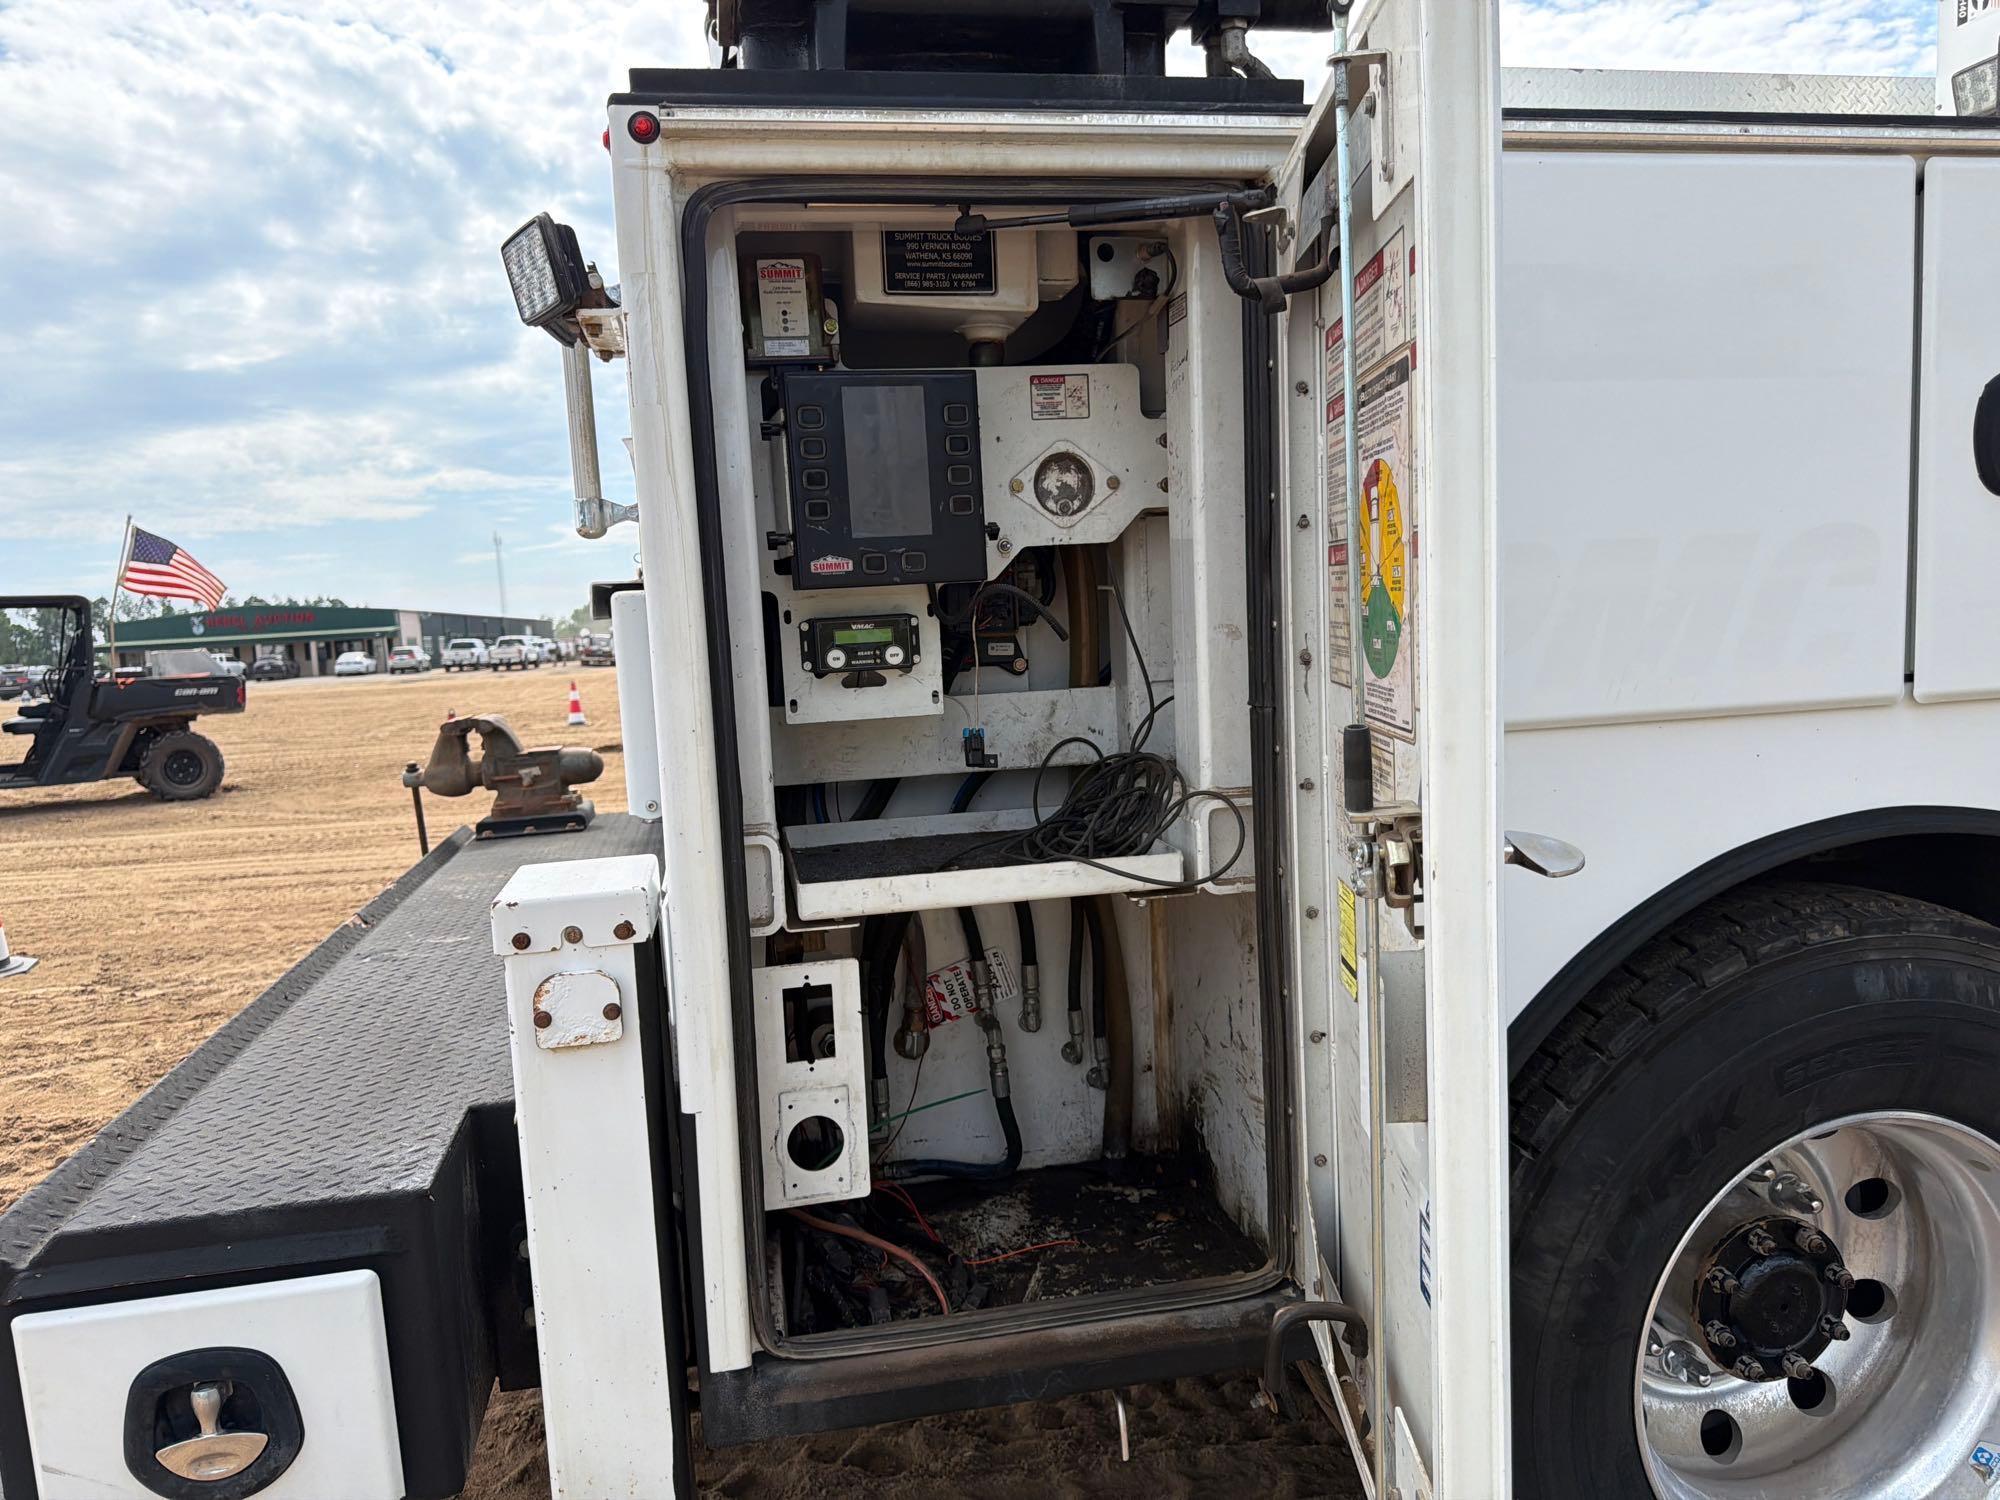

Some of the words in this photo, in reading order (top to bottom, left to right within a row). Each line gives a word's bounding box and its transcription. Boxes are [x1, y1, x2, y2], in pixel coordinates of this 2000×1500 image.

[895, 232, 923, 241] SUMMIT
[927, 232, 952, 241] TRUCK
[906, 242, 919, 250] 990
[921, 242, 950, 250] VERNON
[951, 242, 971, 250] ROAD
[905, 252, 940, 261] WATHENA,
[942, 252, 951, 260] KS
[953, 252, 973, 260] 66090
[760, 269, 801, 279] SUMMIT
[895, 272, 920, 280] SERVICE
[926, 272, 945, 280] PARTS
[952, 272, 984, 280] WARRANTY
[813, 561, 850, 572] SUMMIT
[944, 979, 956, 997] NOT
[953, 969, 973, 1009] OPERATE
[951, 998, 961, 1011] DO
